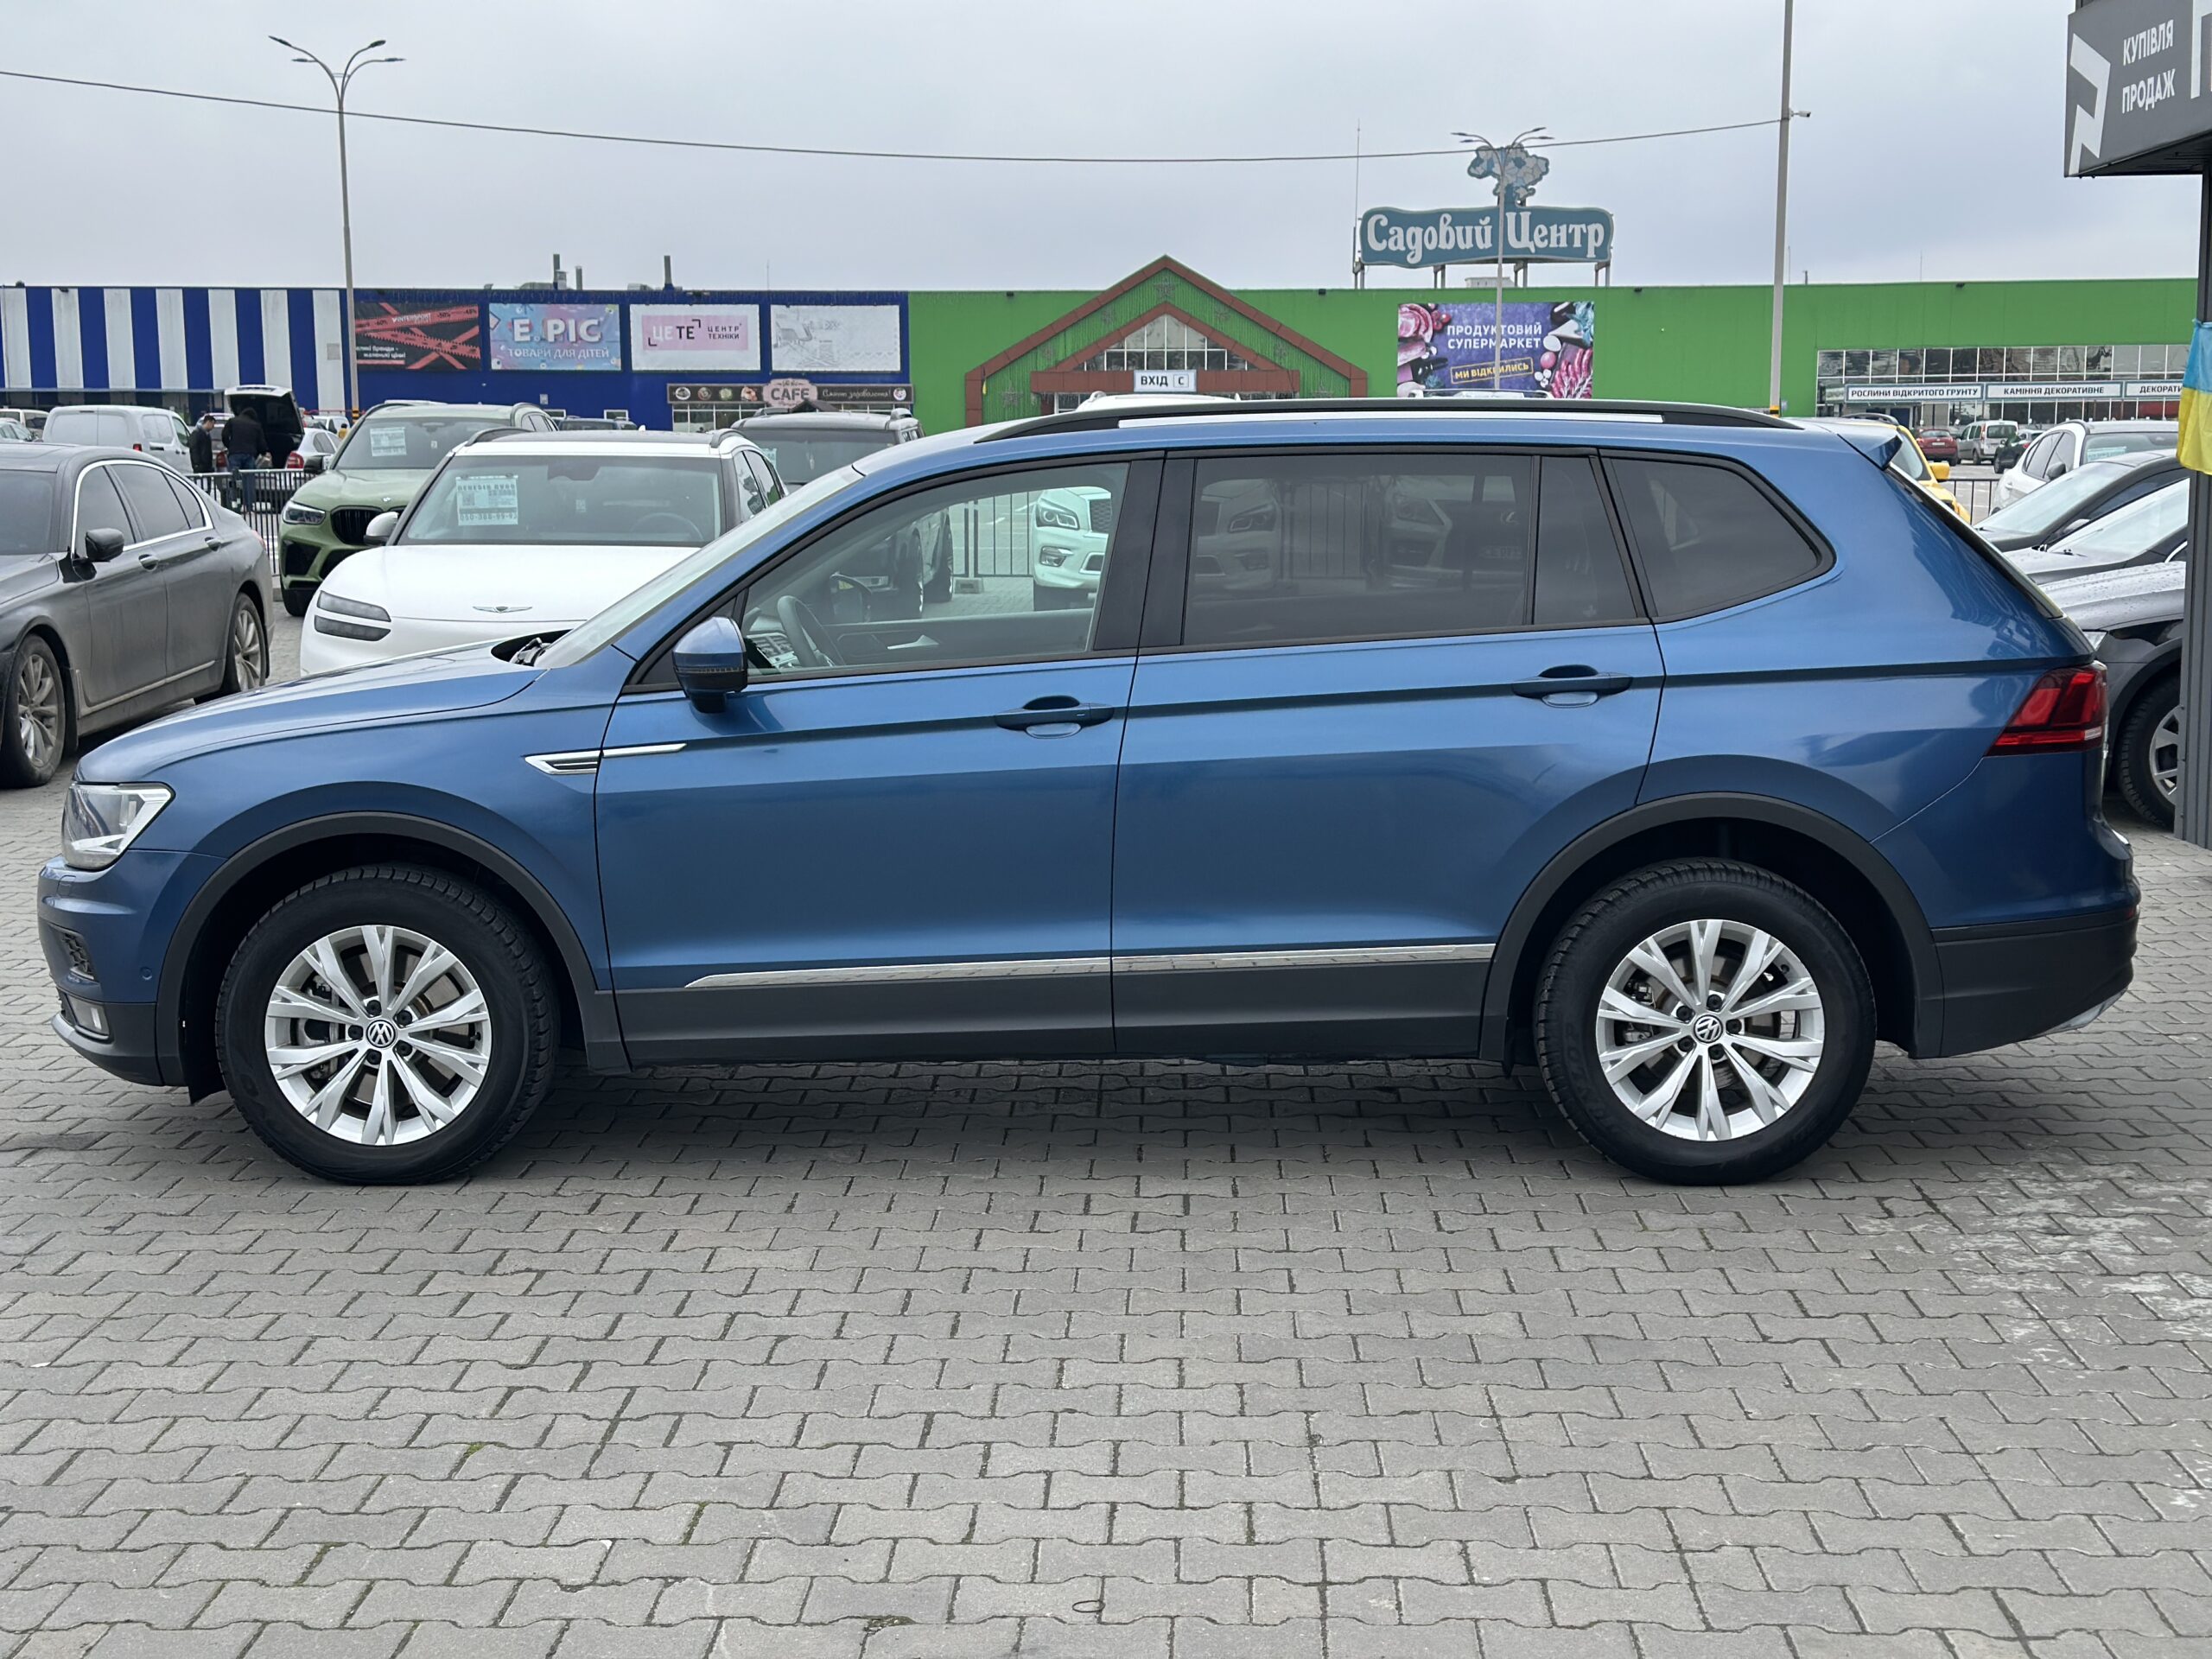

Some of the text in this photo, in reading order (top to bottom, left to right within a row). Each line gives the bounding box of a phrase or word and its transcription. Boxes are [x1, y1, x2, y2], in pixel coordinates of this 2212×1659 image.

[2123, 19, 2174, 66] КУПІВЛЯ
[2122, 68, 2176, 114] ПРОДАЖ
[1367, 212, 1605, 264] Садовий Центр
[1446, 322, 1542, 337] ПРОДУКТОВИЙ
[1448, 338, 1541, 349] СУПЕРМАРКЕТ
[508, 347, 609, 359] ТОВАРИ ДЛЯ ДІТЕЙ
[1455, 363, 1529, 379] МИ ВІДКИЛИСЬ
[1141, 376, 1168, 386] ВХІД
[771, 388, 810, 401] CAFE
[1893, 389, 1945, 397] ВІДКРИТОГО
[2044, 386, 2104, 395] ДЕКОРАТИВНЕ
